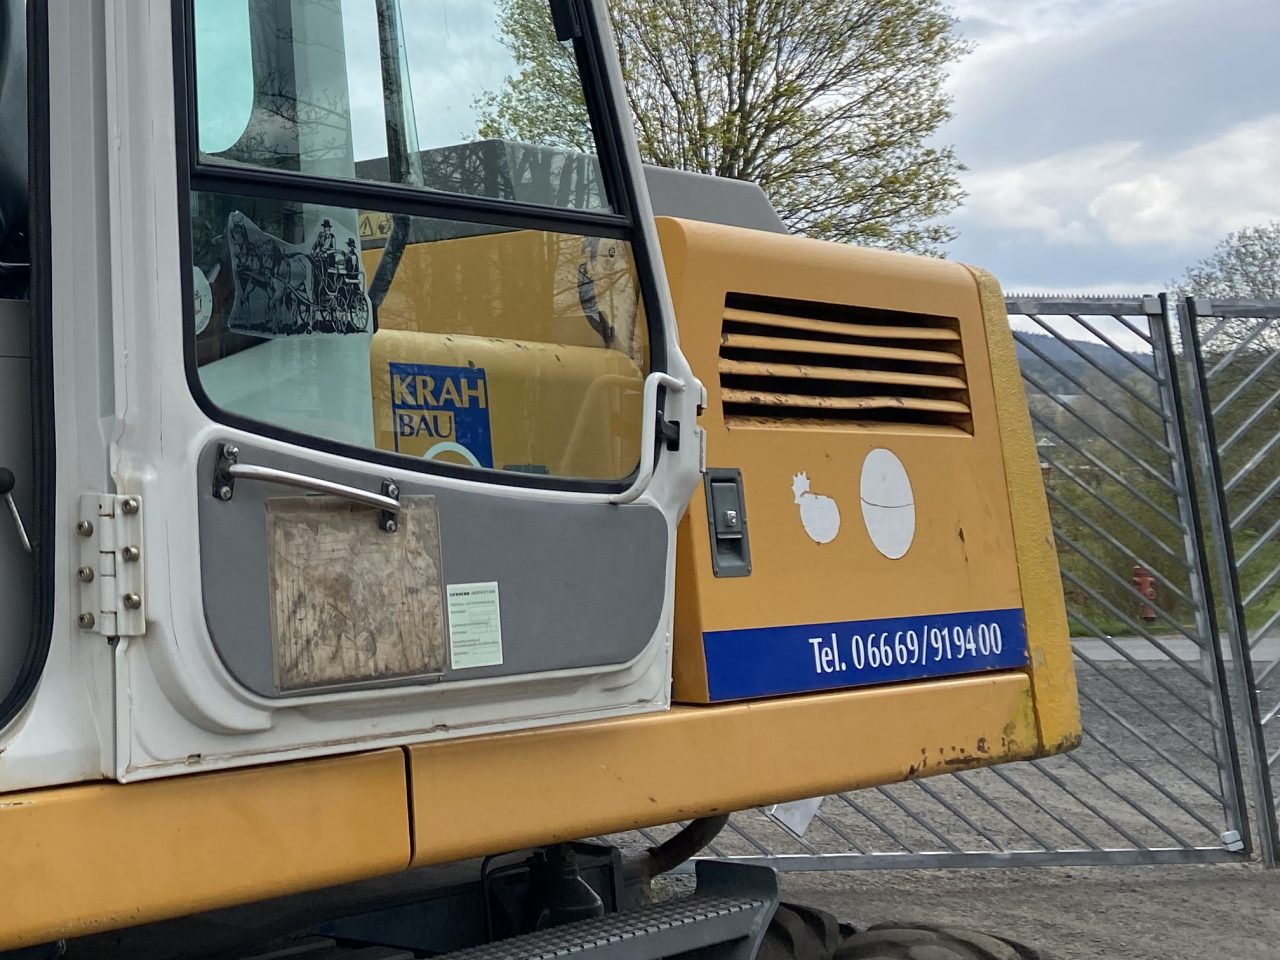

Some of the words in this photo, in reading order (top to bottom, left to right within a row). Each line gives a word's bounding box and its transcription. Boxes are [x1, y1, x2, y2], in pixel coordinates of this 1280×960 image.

[393, 374, 487, 409] KRAH
[398, 413, 453, 438] BAU
[809, 633, 847, 674] Tel.
